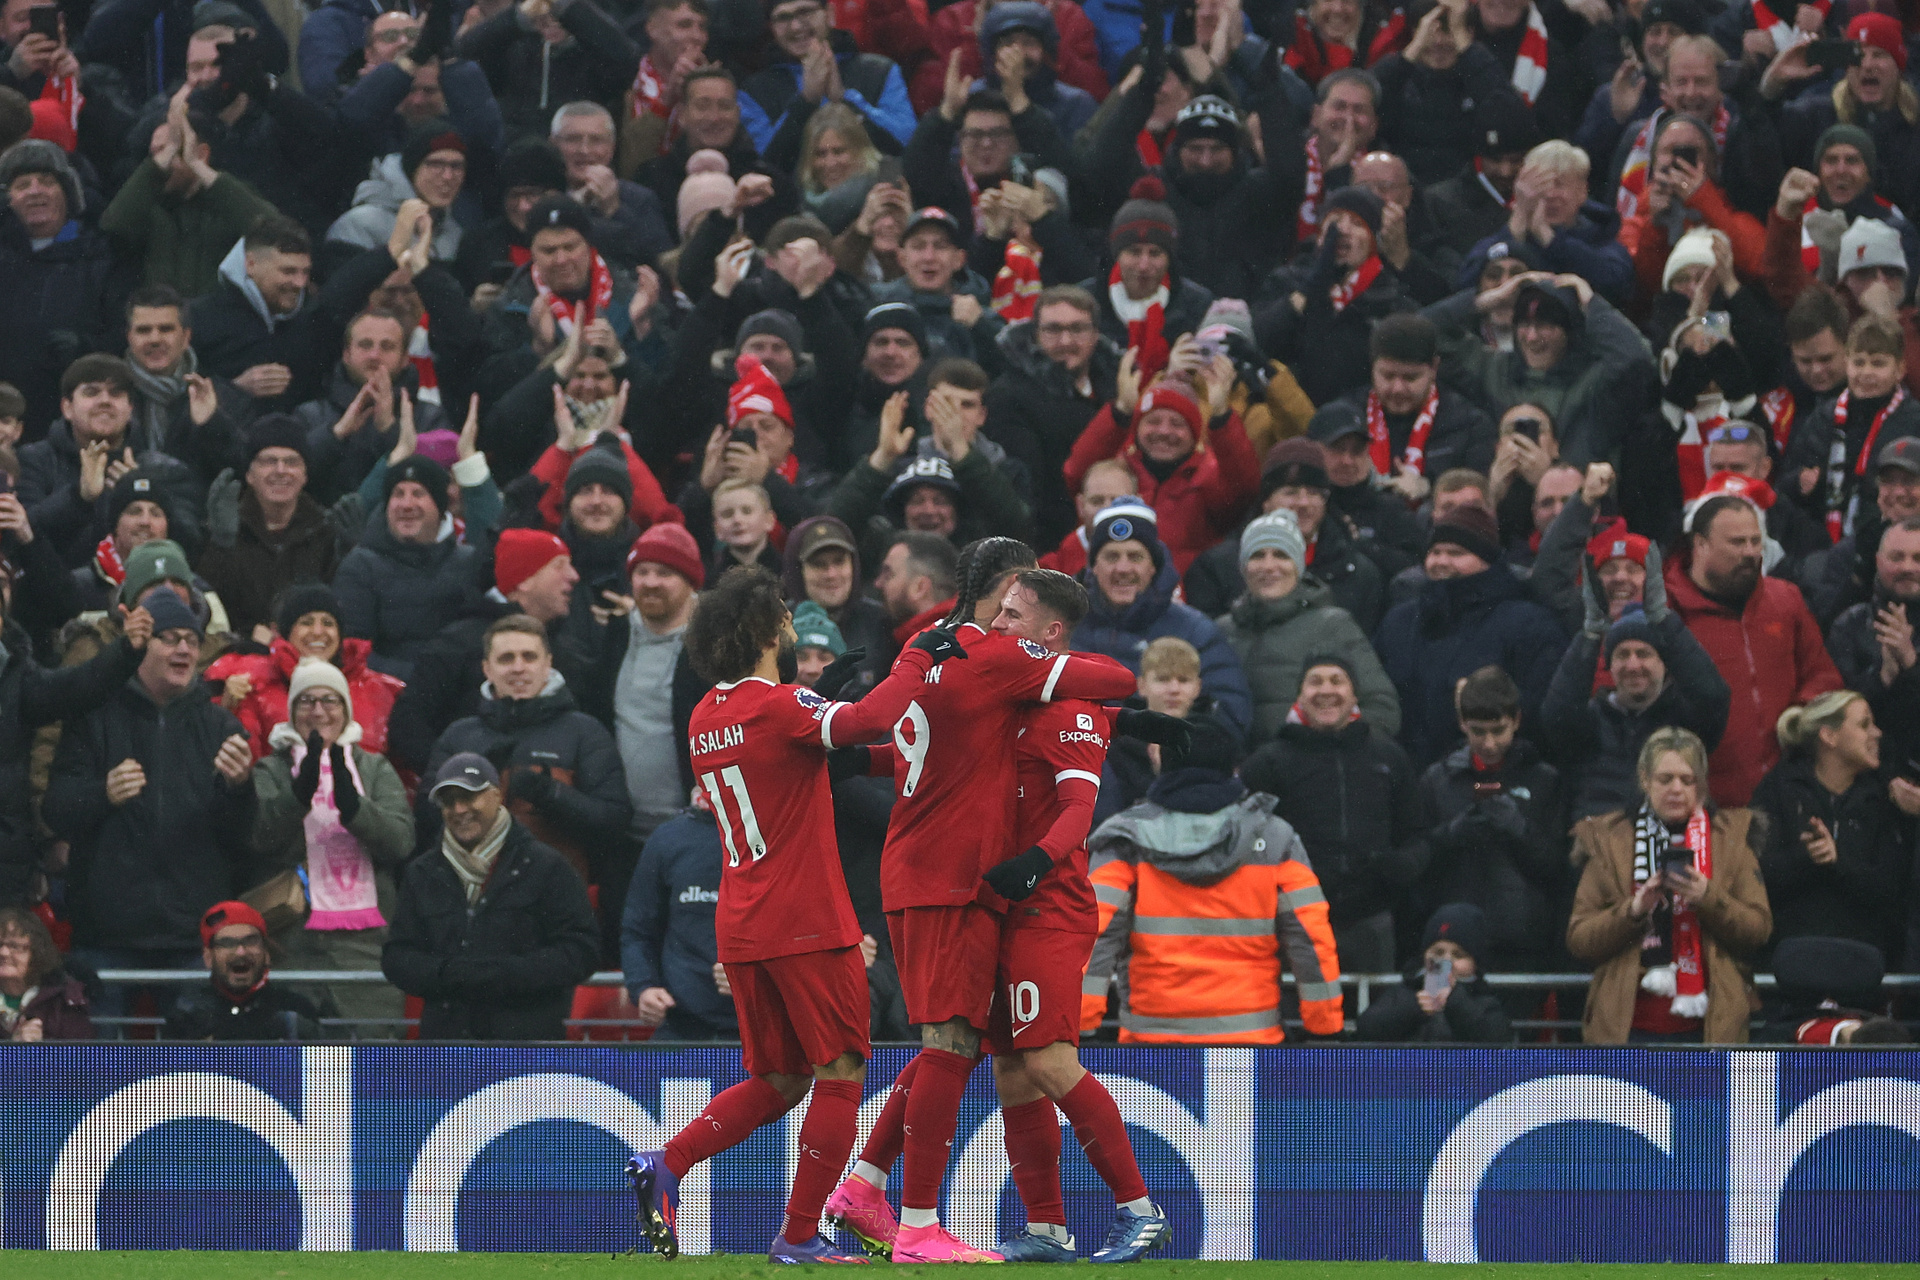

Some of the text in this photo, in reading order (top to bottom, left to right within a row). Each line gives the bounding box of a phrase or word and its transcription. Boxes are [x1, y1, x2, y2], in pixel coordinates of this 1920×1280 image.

[893, 700, 931, 798] 9
[701, 765, 767, 868] 11
[1008, 980, 1040, 1024] 10
